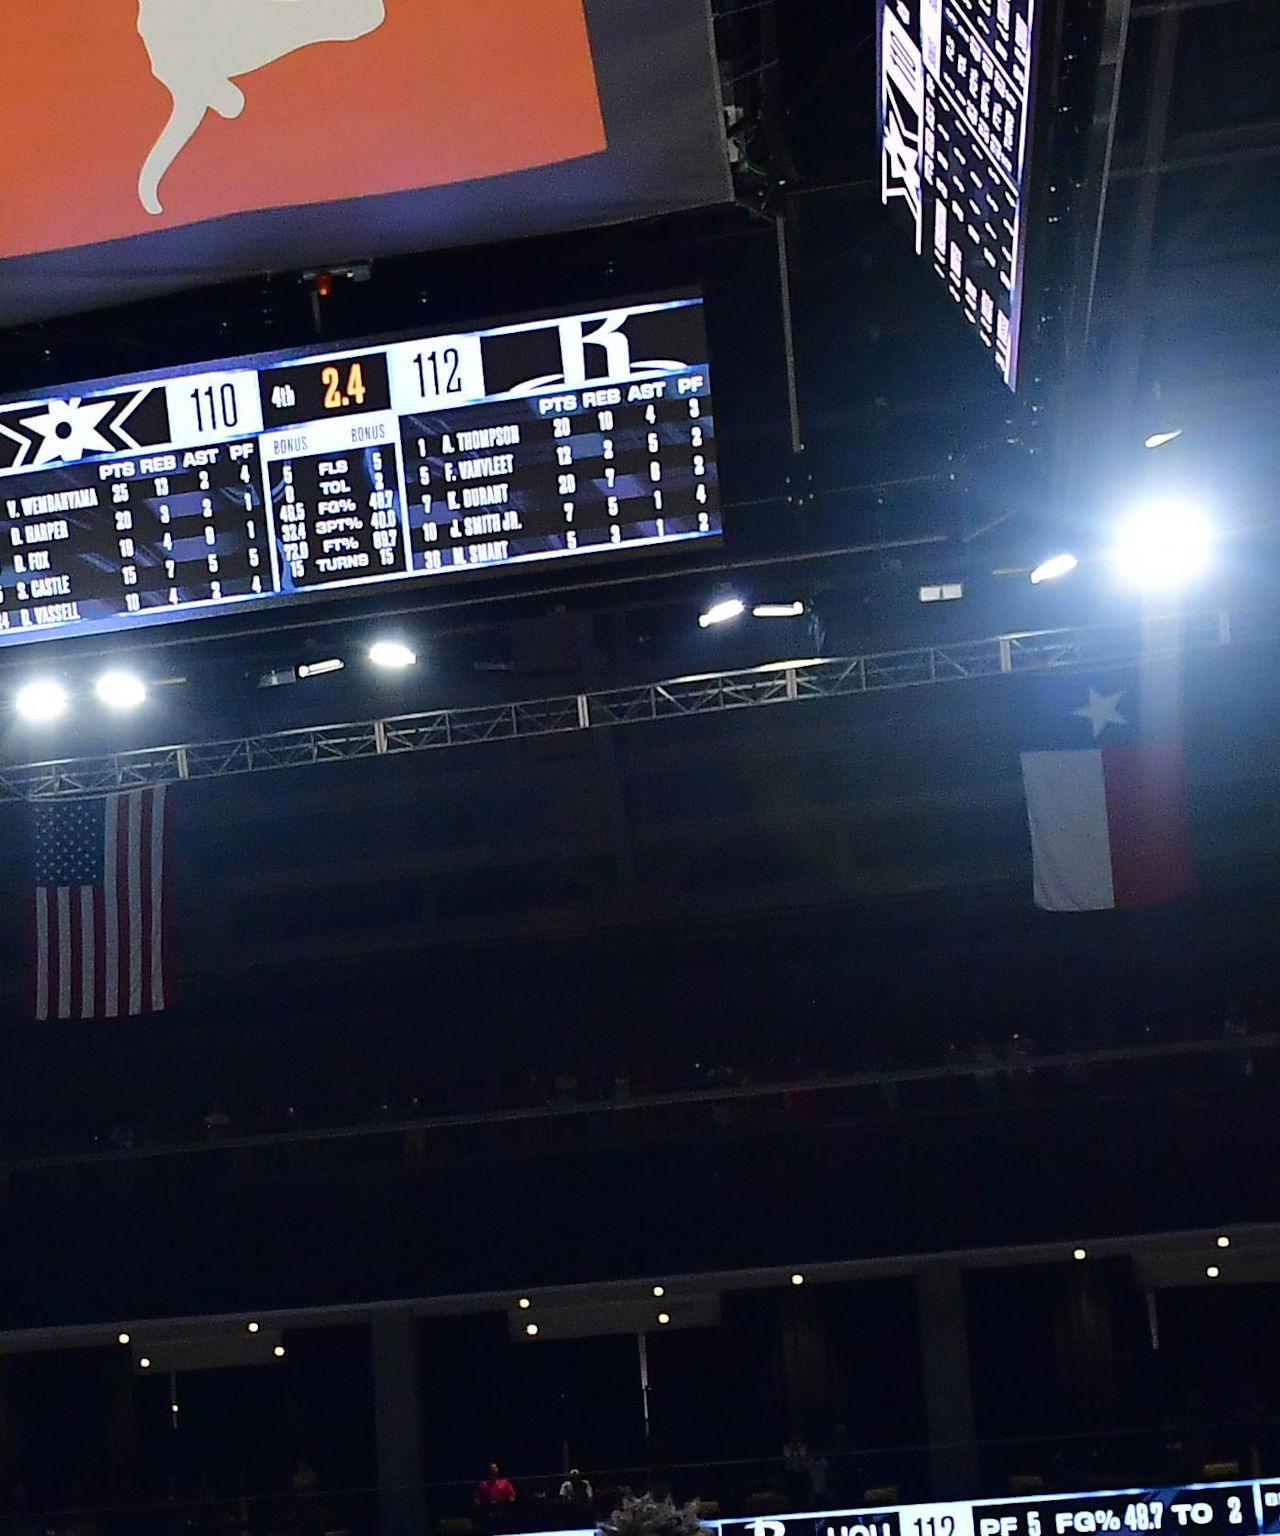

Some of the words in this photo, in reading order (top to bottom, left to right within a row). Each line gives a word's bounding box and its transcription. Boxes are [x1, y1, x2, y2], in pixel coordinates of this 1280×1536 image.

[271, 384, 295, 408] 4th
[322, 363, 366, 409] 2.4
[413, 347, 462, 397] 112
[191, 383, 238, 432] 110
[539, 395, 577, 415] PTS
[583, 389, 621, 408] REB
[628, 381, 666, 401] AST
[678, 376, 703, 394] PF
[273, 436, 308, 455] BONUS
[351, 424, 385, 443] BONUS
[418, 439, 426, 457] 1
[456, 425, 520, 452] THOMPSON
[99, 462, 135, 480] PTS
[140, 455, 176, 473] REB
[183, 449, 219, 468] AST
[230, 443, 253, 461] PF
[458, 454, 514, 480] VANVLEET
[557, 446, 572, 466] 12
[112, 483, 129, 503] 25
[320, 480, 351, 495] TOL
[463, 484, 509, 508] DURANT
[25, 521, 68, 544] HARPER
[245, 493, 252, 511] 1
[318, 498, 356, 515] FG%
[464, 513, 502, 537] SMITH
[654, 491, 662, 510] 1
[316, 517, 363, 535] 3PT%
[28, 551, 51, 571] FOX
[247, 521, 254, 539] 1
[323, 537, 359, 553] FT%
[469, 540, 509, 563] SMART
[316, 553, 368, 571] TURNS
[31, 575, 71, 598] CASTLE
[122, 566, 137, 585] 15
[33, 603, 80, 625] VASSELL
[1056, 1510, 1121, 1535] FG%
[1125, 1502, 1164, 1531] 48.7
[1171, 1502, 1213, 1526] TO
[1227, 1496, 1243, 1524] 2
